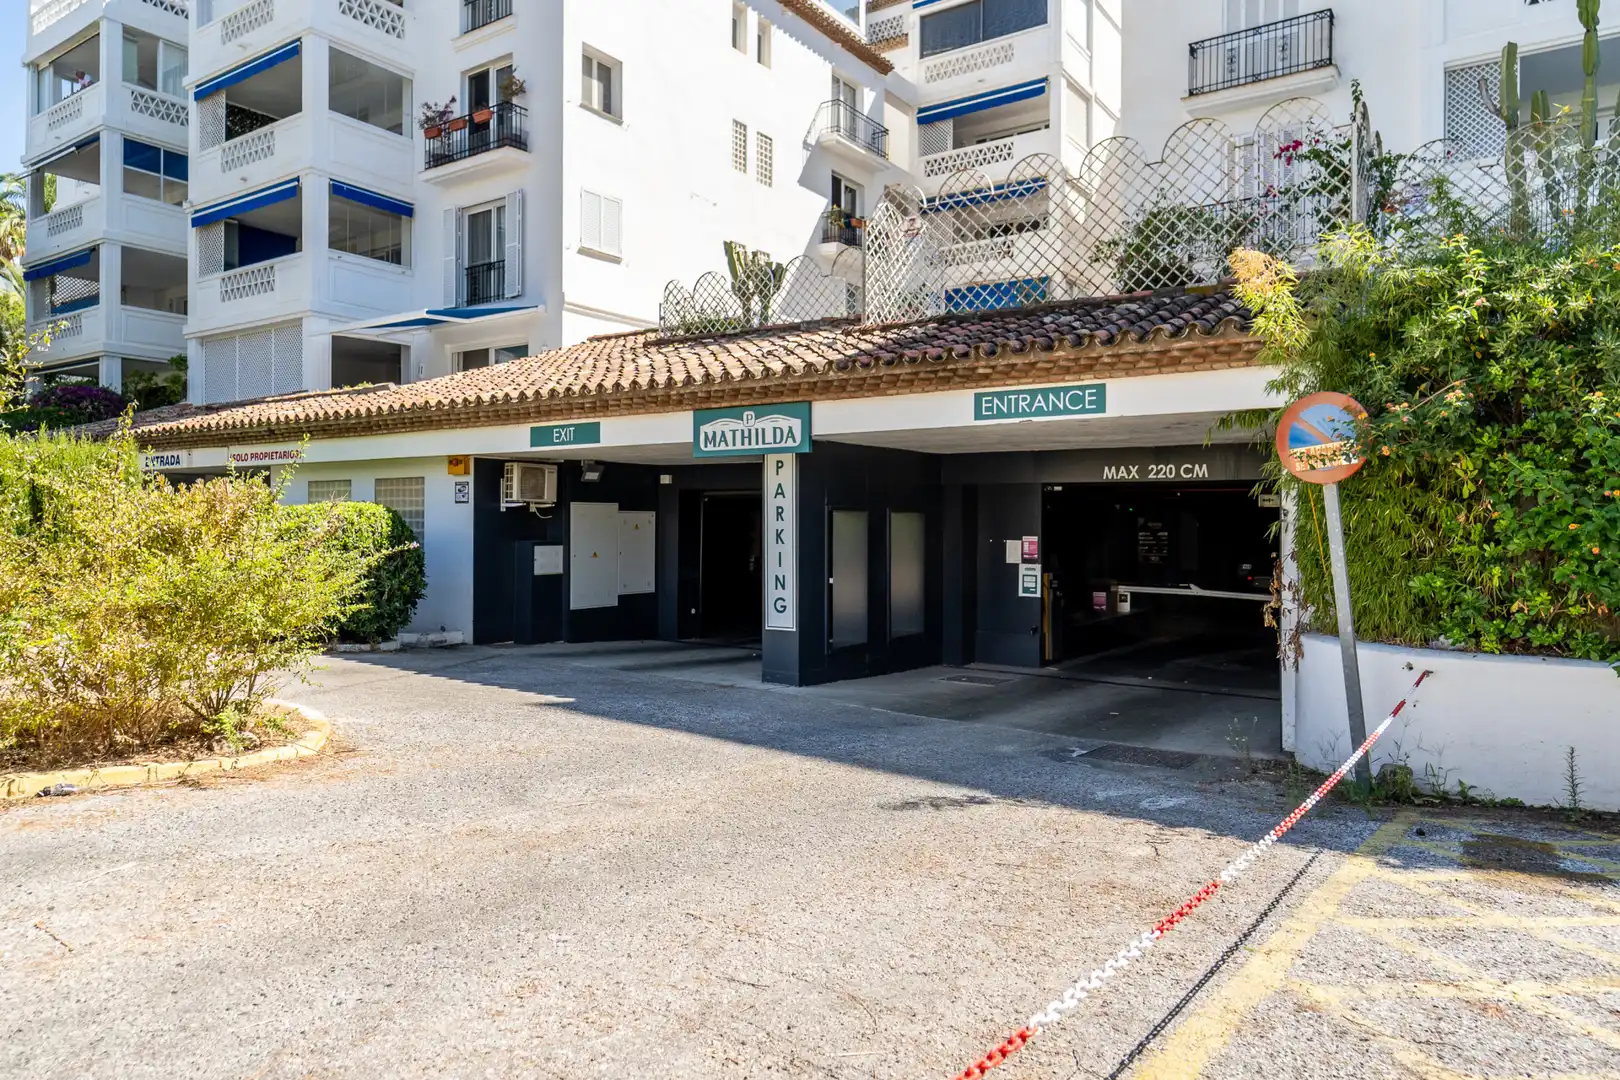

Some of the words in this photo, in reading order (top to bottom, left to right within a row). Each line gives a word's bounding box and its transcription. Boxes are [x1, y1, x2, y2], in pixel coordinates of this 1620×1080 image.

[982, 389, 1097, 415] ENTRANCE
[745, 413, 753, 425] P
[553, 427, 575, 443] EXIT
[703, 426, 797, 449] MATHILDA
[1102, 465, 1140, 480] MAX
[1147, 464, 1176, 479] 220
[1180, 463, 1209, 479] CM
[773, 459, 788, 614] PARKING
